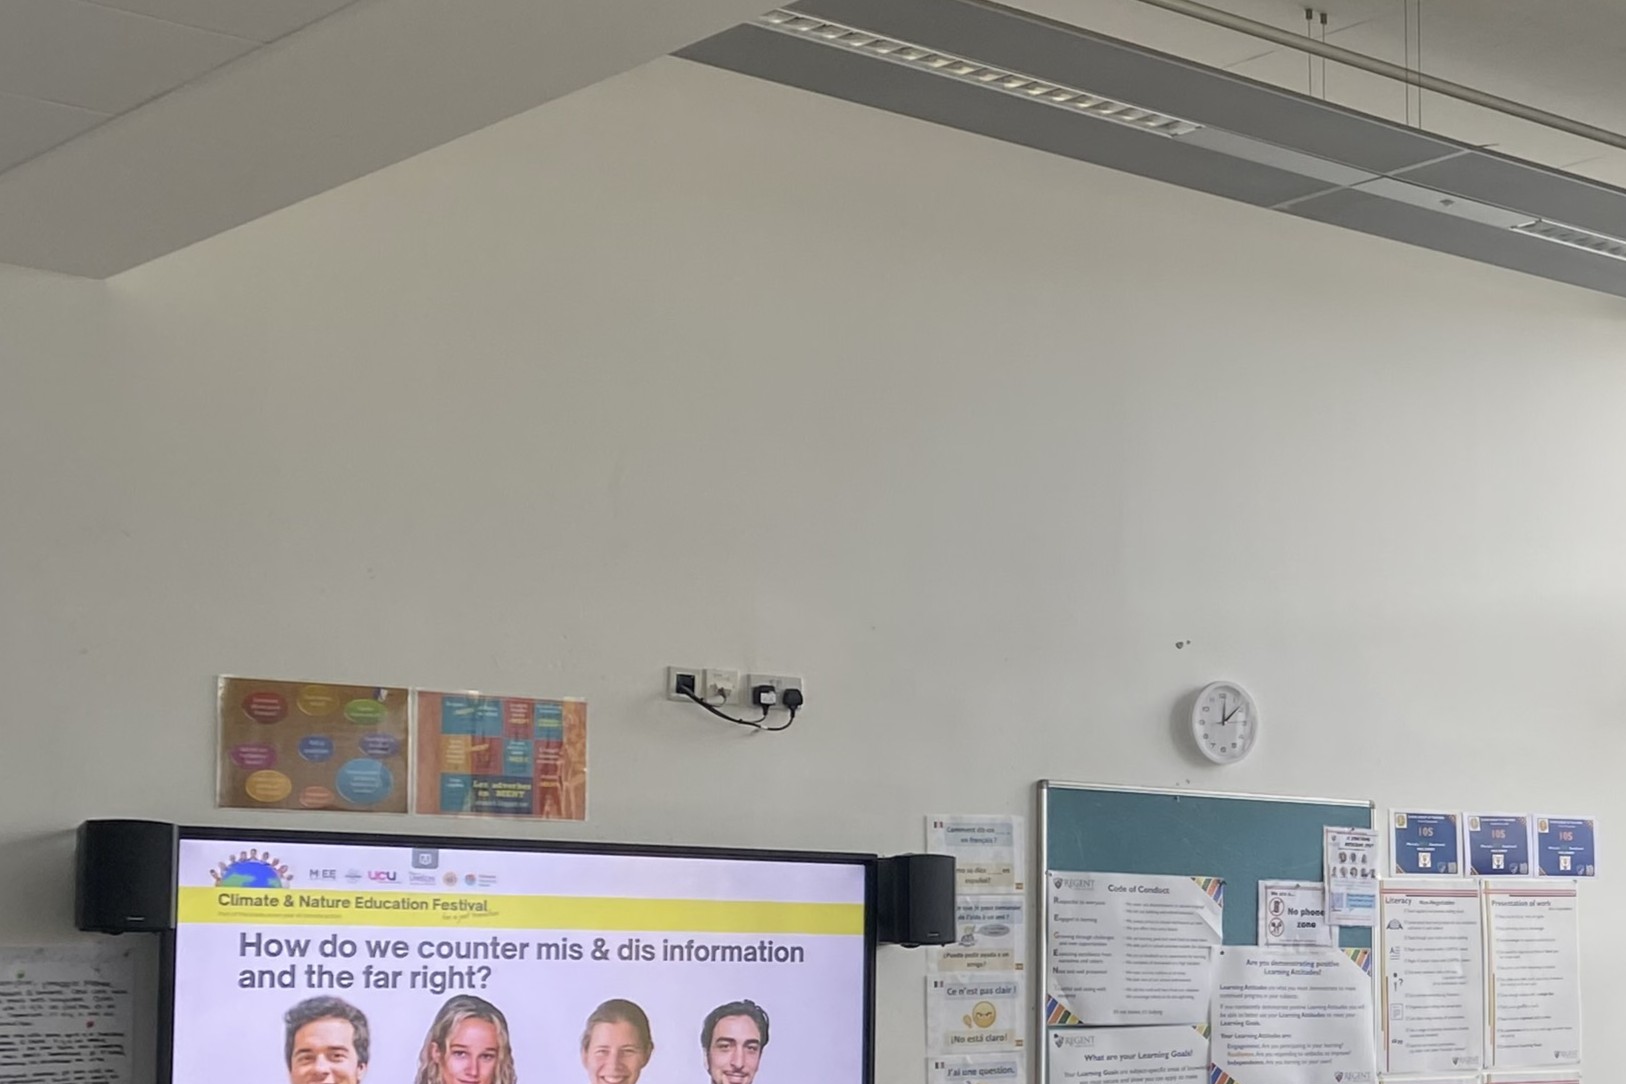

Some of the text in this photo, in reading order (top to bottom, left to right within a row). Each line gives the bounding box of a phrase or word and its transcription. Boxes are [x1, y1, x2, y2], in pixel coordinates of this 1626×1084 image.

[1108, 884, 1170, 894] Code of Conduct
[218, 893, 488, 912] Climate & Nature Education Festival
[1385, 896, 1412, 905] Literacy
[1288, 907, 1325, 917] No phone
[239, 932, 805, 963] How do we counter mis & dis information
[238, 964, 492, 995] and the far right?
